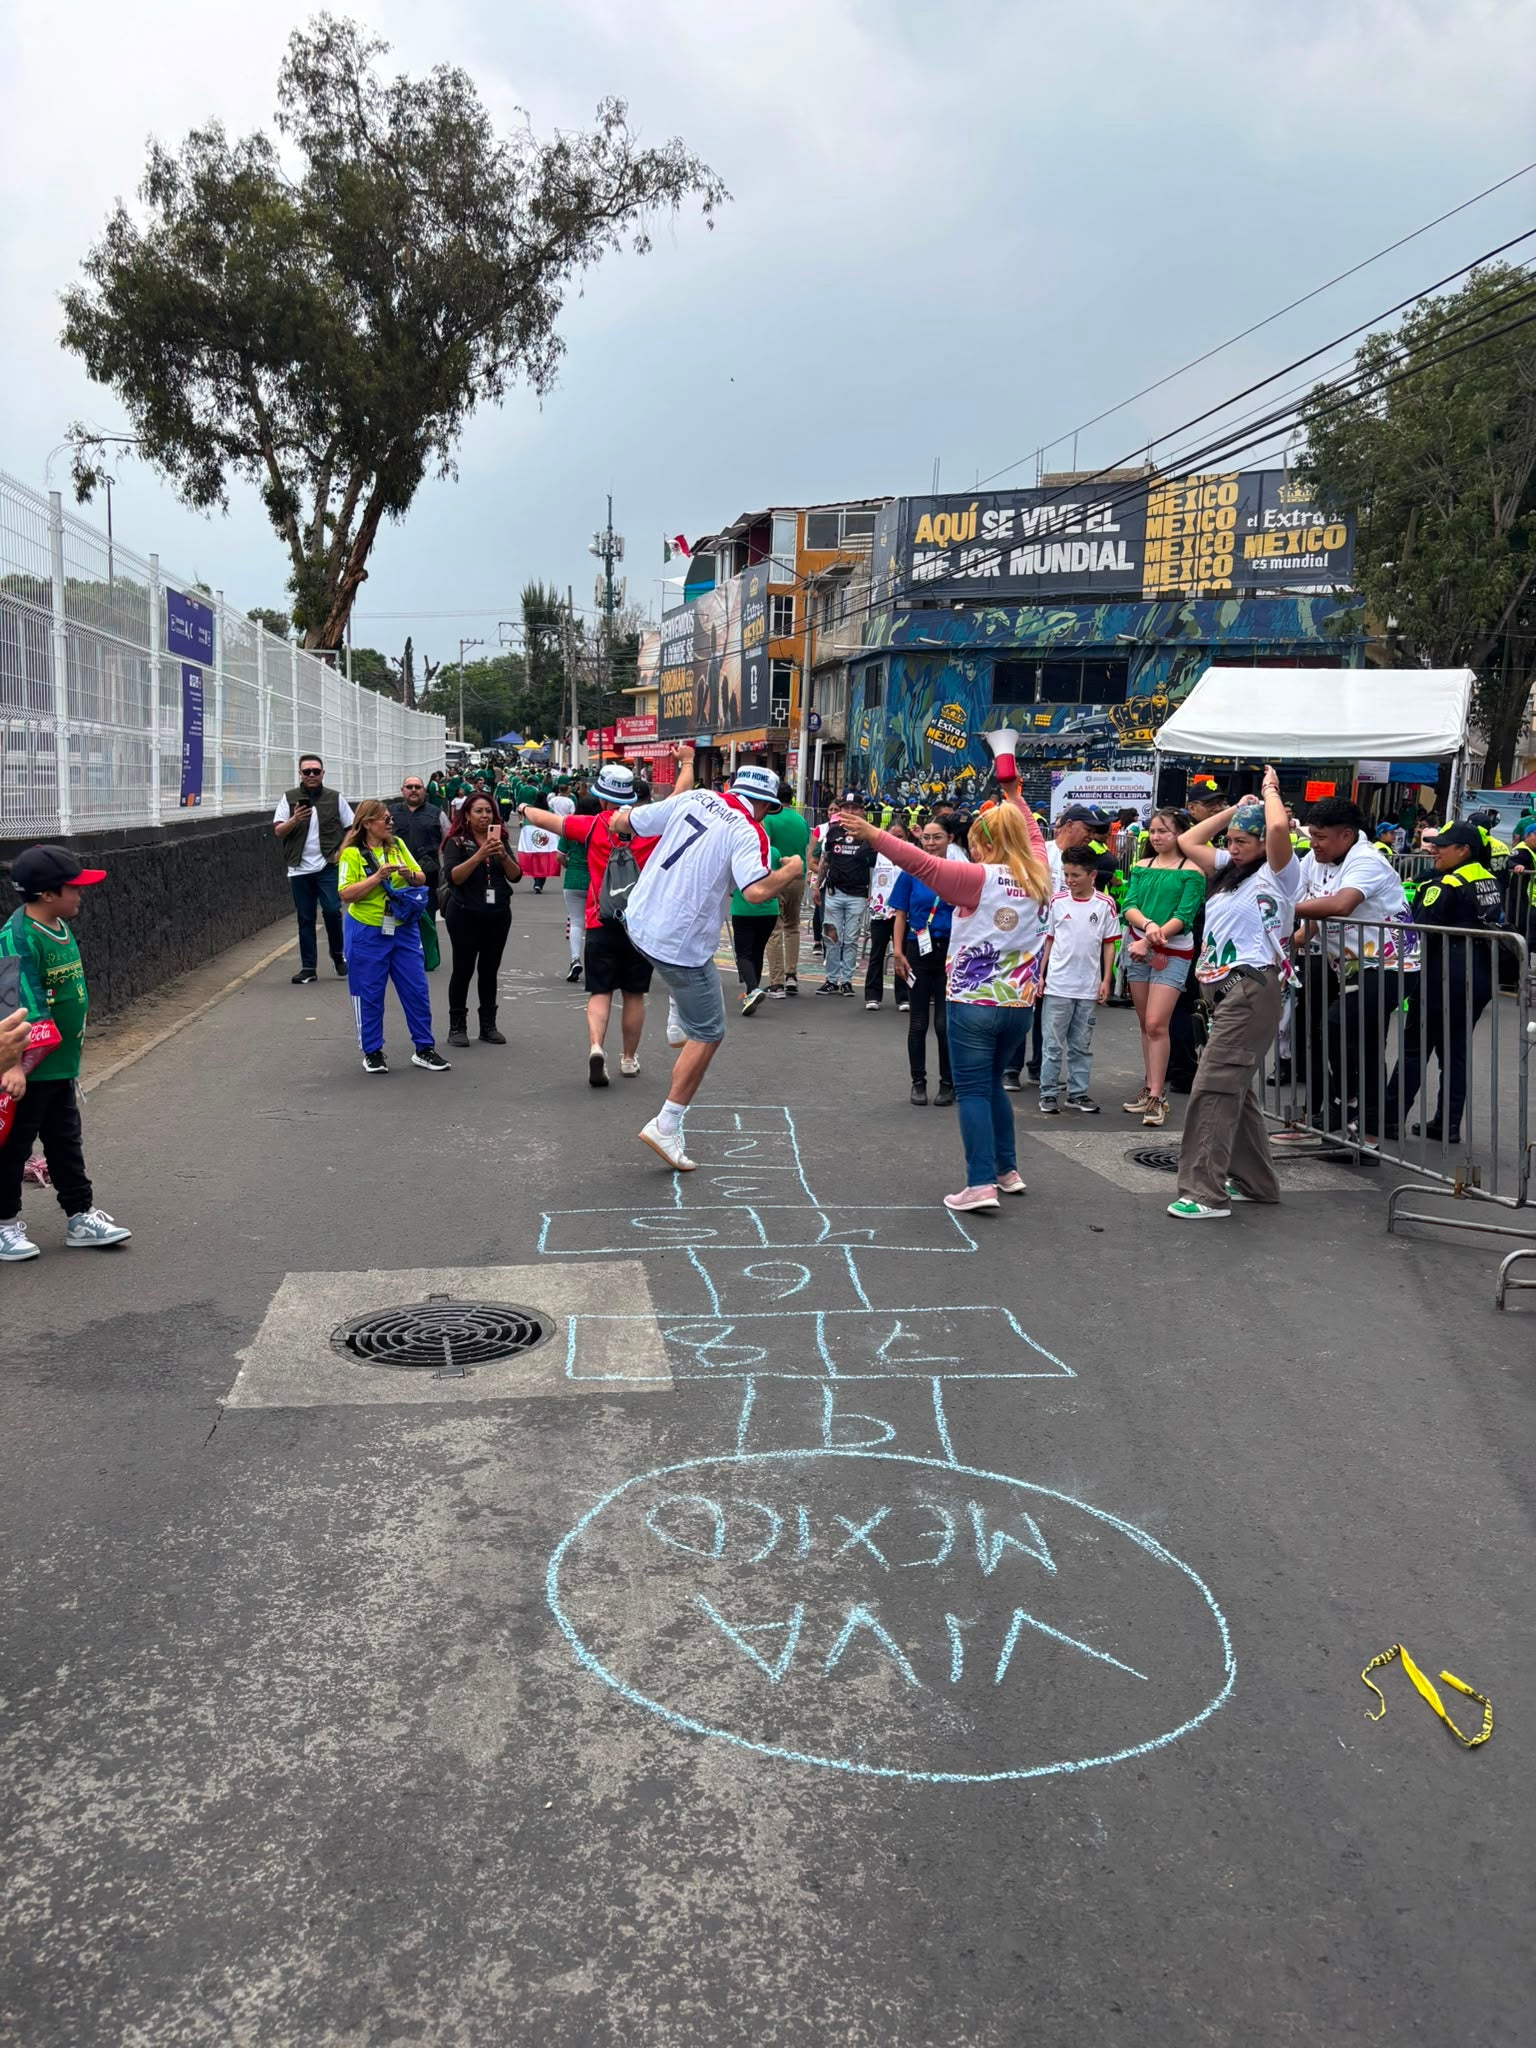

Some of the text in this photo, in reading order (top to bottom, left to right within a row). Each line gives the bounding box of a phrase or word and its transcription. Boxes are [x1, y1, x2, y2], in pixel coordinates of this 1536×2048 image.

[914, 502, 1121, 548] AQUÍ SE VIVE EL
[1247, 514, 1258, 527] el
[1263, 508, 1326, 528] Extra
[1243, 524, 1347, 559] MÉXICO
[911, 540, 1135, 581] MEJOR MUNDIAL
[1252, 552, 1329, 570] es mundial
[937, 719, 961, 736] Extra
[691, 792, 738, 824] ECKHAM
[661, 813, 709, 871] 7
[734, 1113, 742, 1130] 1
[723, 1139, 765, 1158] 2
[709, 1176, 775, 1199] 3
[631, 1216, 718, 1240] 5
[816, 1211, 876, 1244] 4
[743, 1261, 810, 1300] 6
[664, 1323, 766, 1369] 8
[876, 1320, 961, 1363] 7
[822, 1384, 896, 1449] 9
[646, 1494, 1058, 1576] MEXICO
[696, 1594, 1149, 1687] VIVA
